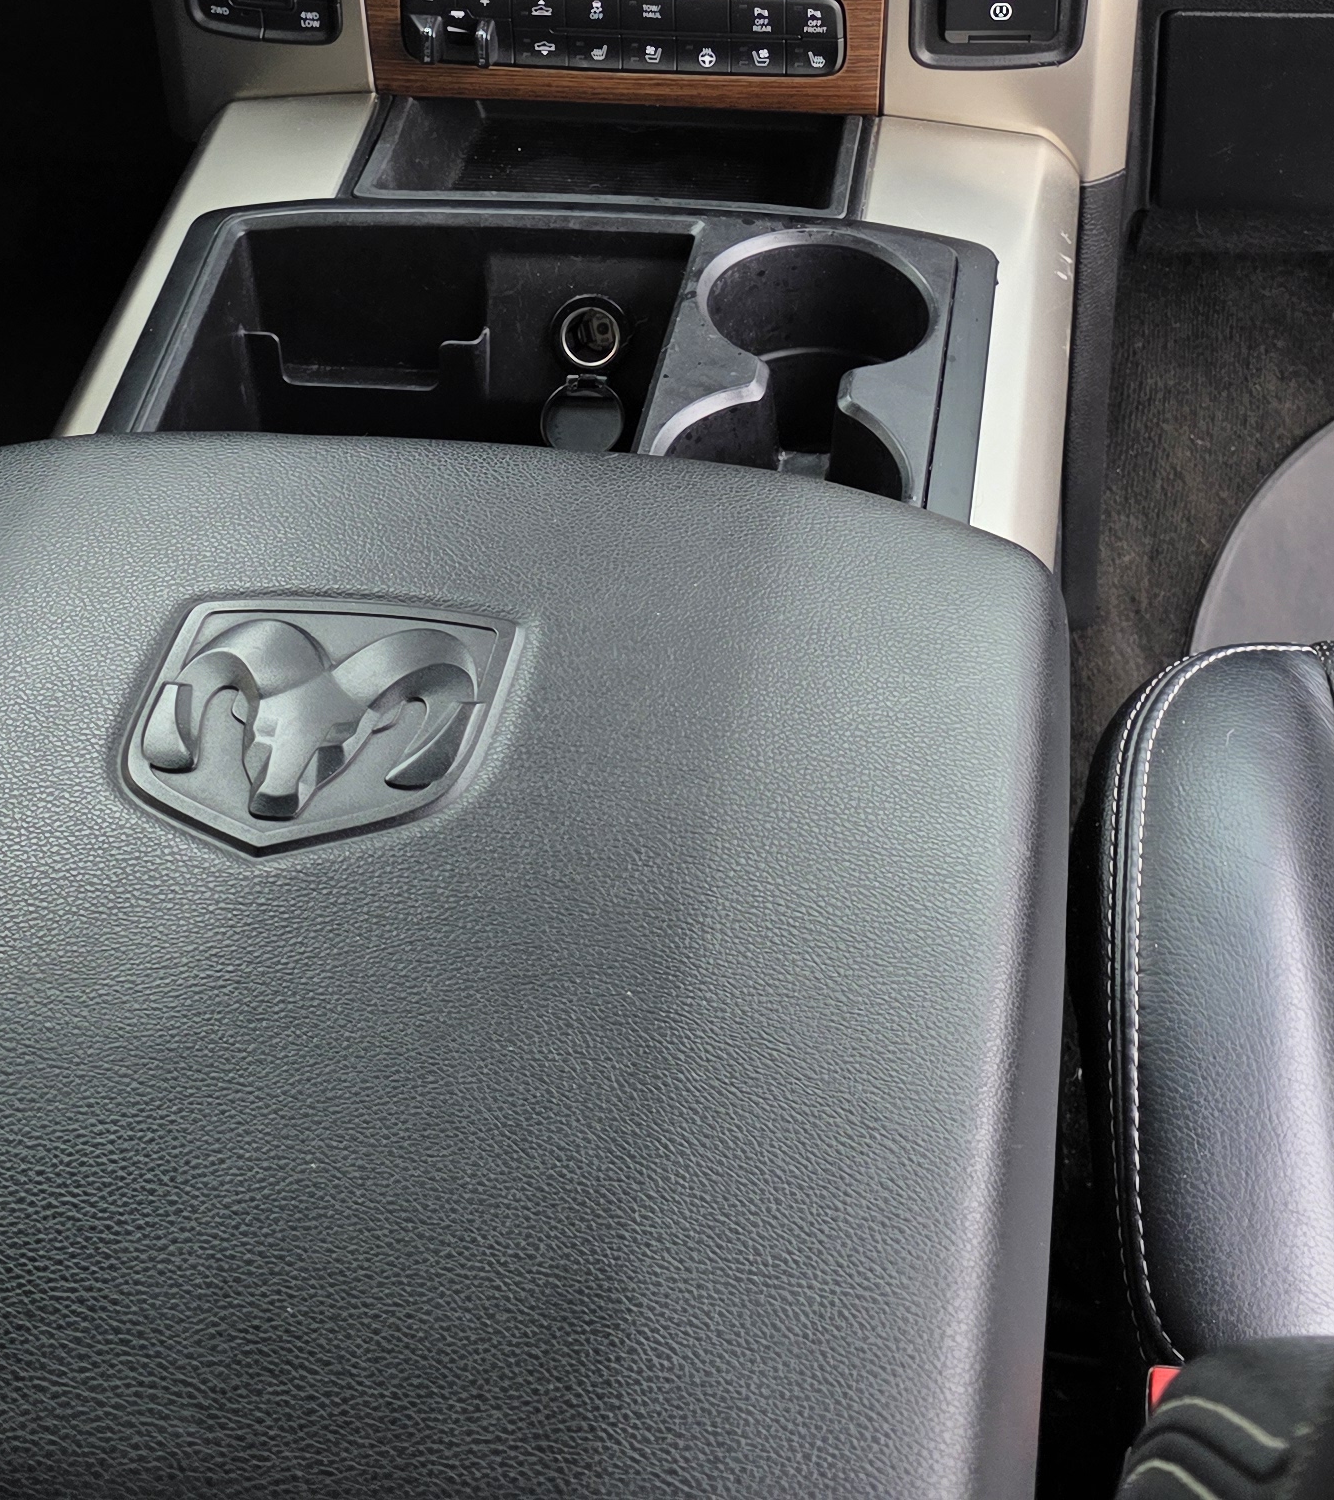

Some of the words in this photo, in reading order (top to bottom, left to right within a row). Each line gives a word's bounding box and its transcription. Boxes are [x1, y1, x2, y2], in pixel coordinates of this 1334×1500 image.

[210, 4, 230, 15] 2WD
[300, 11, 320, 20] 4WD
[300, 19, 321, 28] LOW
[803, 26, 827, 34] FRONT
